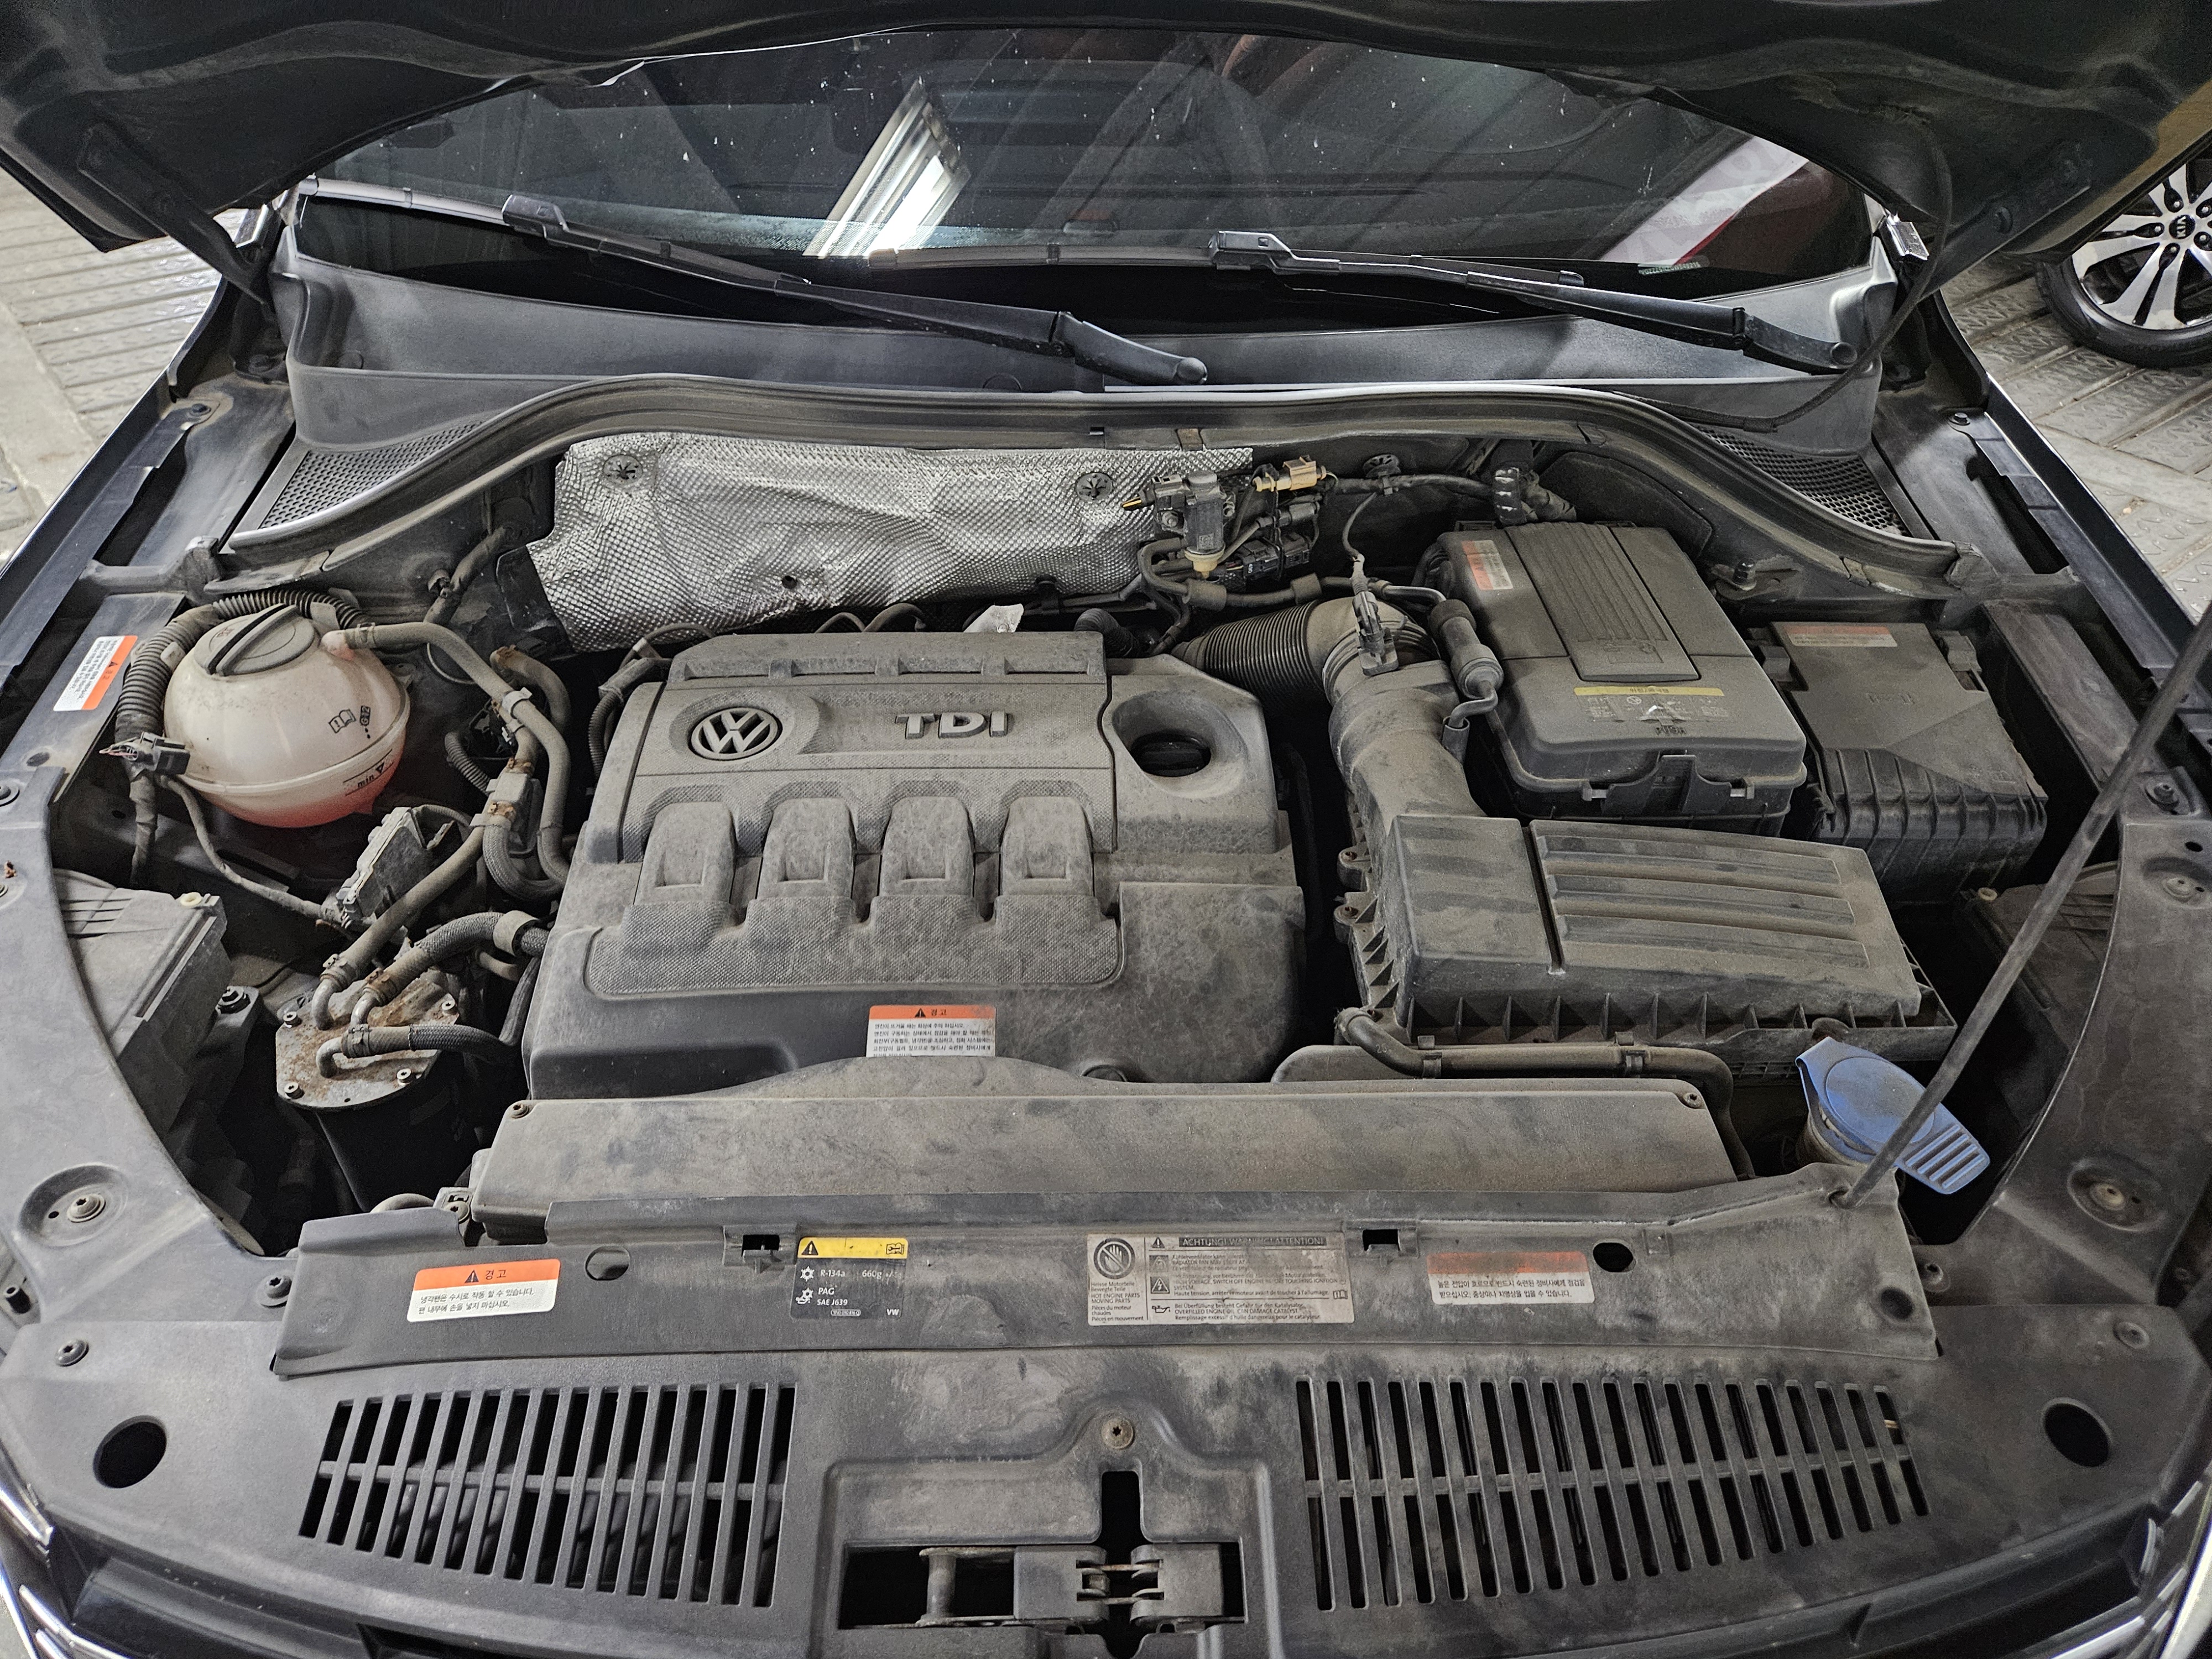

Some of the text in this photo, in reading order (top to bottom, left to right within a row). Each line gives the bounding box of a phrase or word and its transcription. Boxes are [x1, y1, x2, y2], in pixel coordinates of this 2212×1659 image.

[2177, 216, 2186, 237] KIA
[895, 711, 1009, 739] TDI
[357, 775, 374, 788] min
[486, 1269, 506, 1280] 경고
[862, 1270, 882, 1280] 660g
